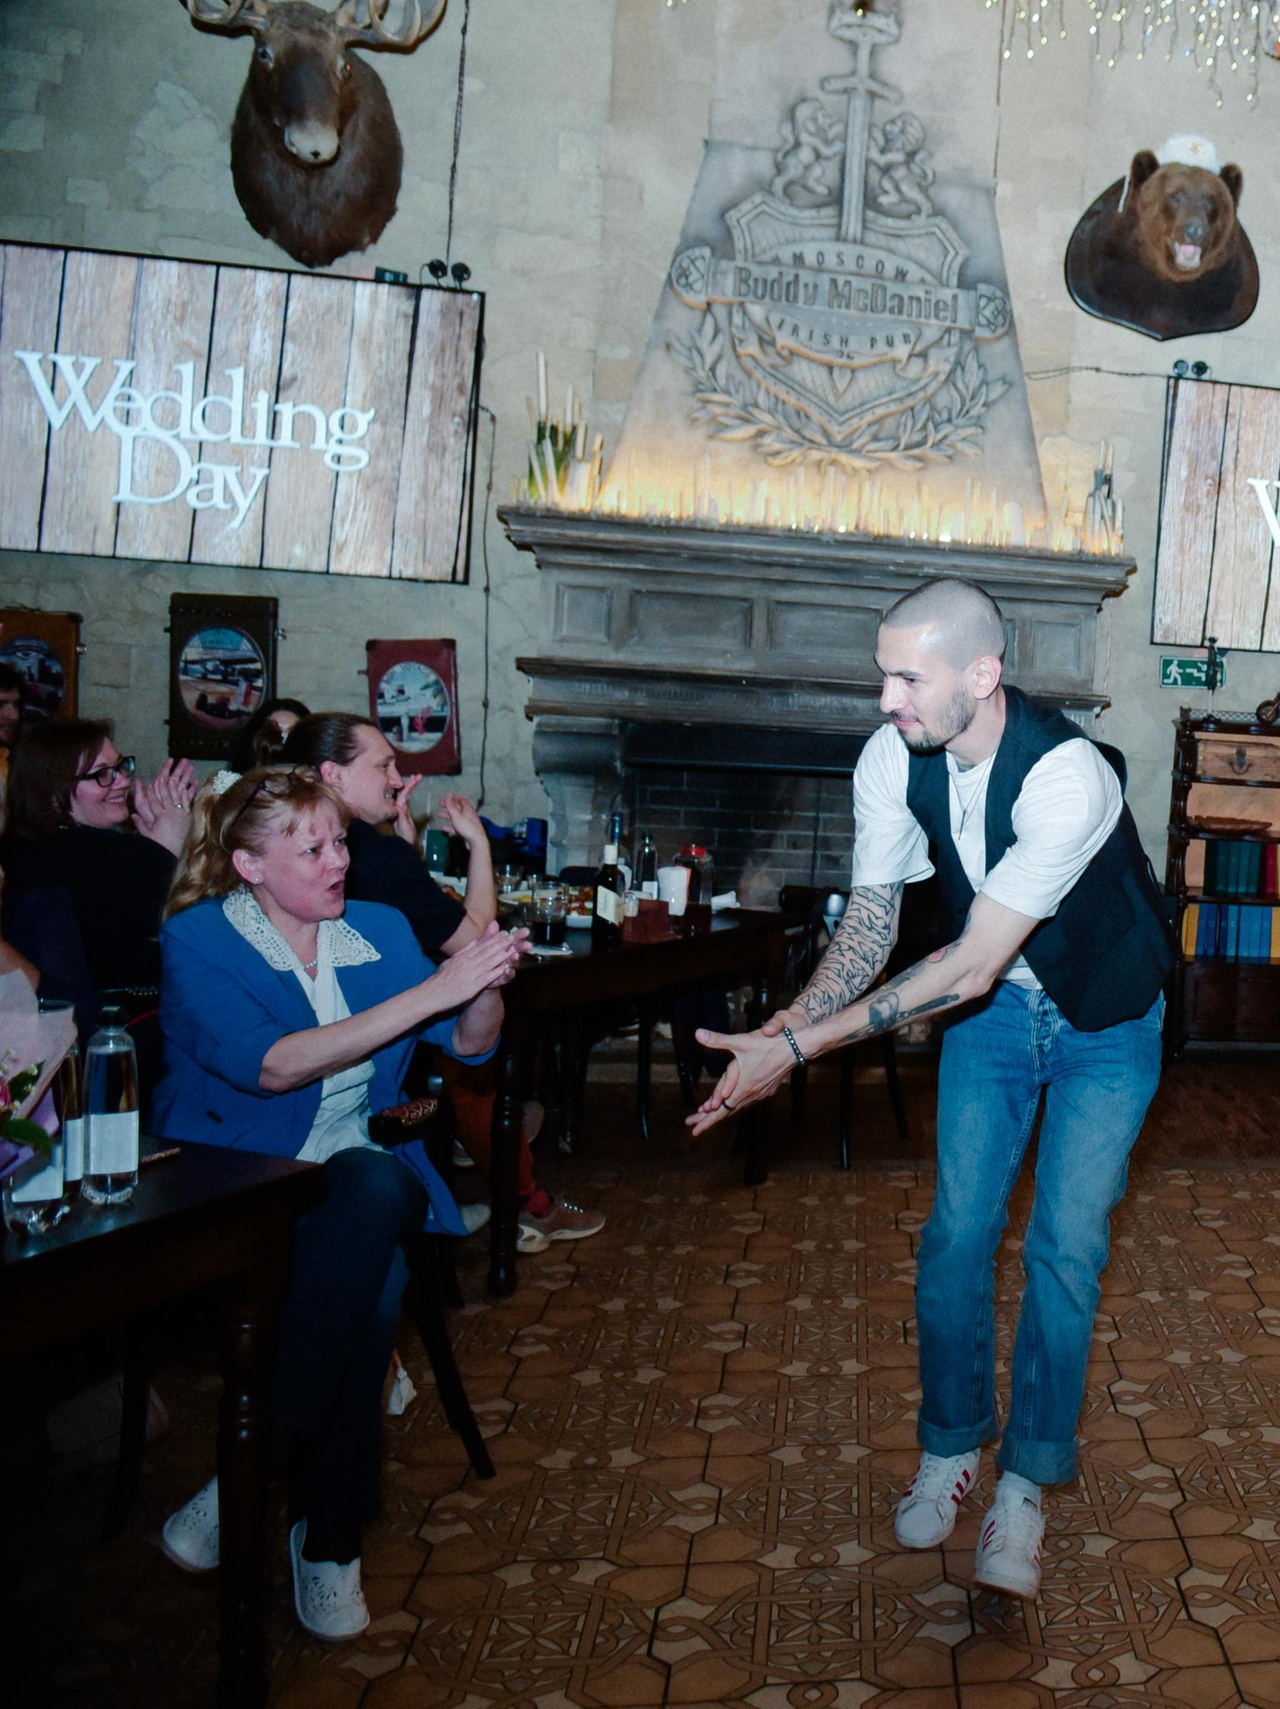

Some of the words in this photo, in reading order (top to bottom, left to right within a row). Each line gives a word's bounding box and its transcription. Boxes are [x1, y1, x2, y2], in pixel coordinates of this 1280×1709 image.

[792, 251, 909, 283] MOSCOW
[827, 277, 959, 323] McDaniel
[777, 318, 849, 347] IRISH
[870, 333, 912, 349] PUB
[14, 349, 377, 472] Wedding
[112, 428, 270, 530] Day
